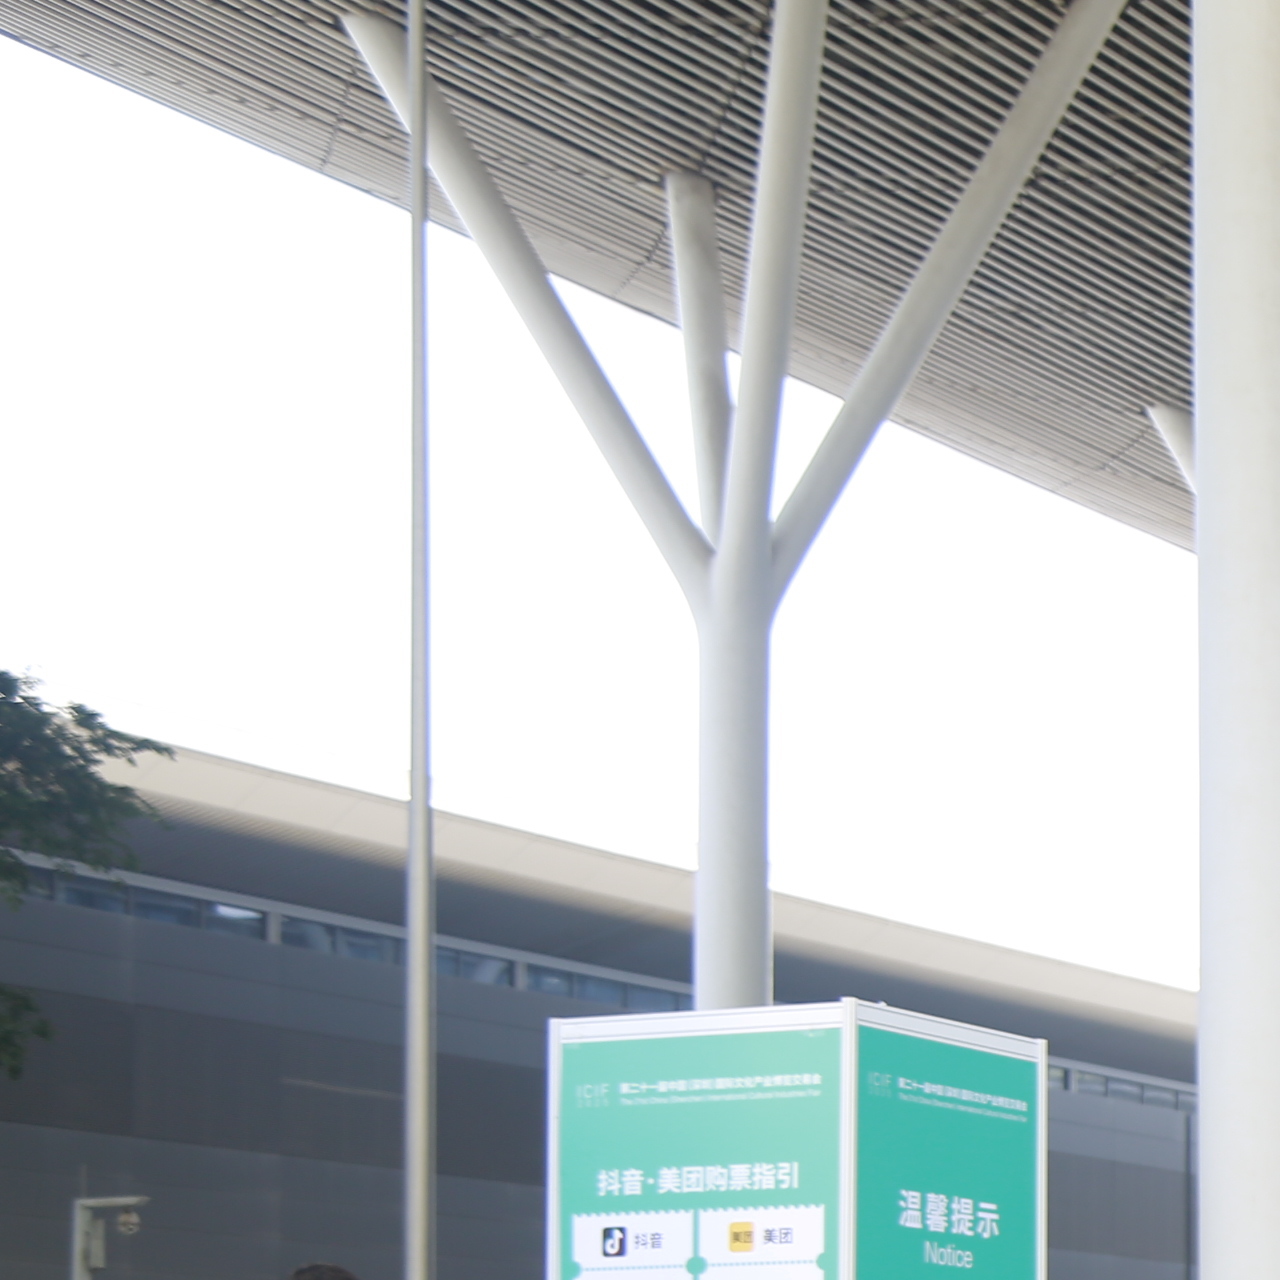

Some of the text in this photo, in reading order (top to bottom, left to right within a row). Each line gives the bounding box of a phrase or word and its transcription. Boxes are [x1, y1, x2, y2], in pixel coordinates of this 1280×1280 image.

[597, 1162, 800, 1197] 抖音·美团购票指引
[898, 1188, 1000, 1239] 温馨提示
[634, 1232, 664, 1250] 抖音
[763, 1228, 794, 1245] 美团
[924, 1241, 974, 1269] Notice
